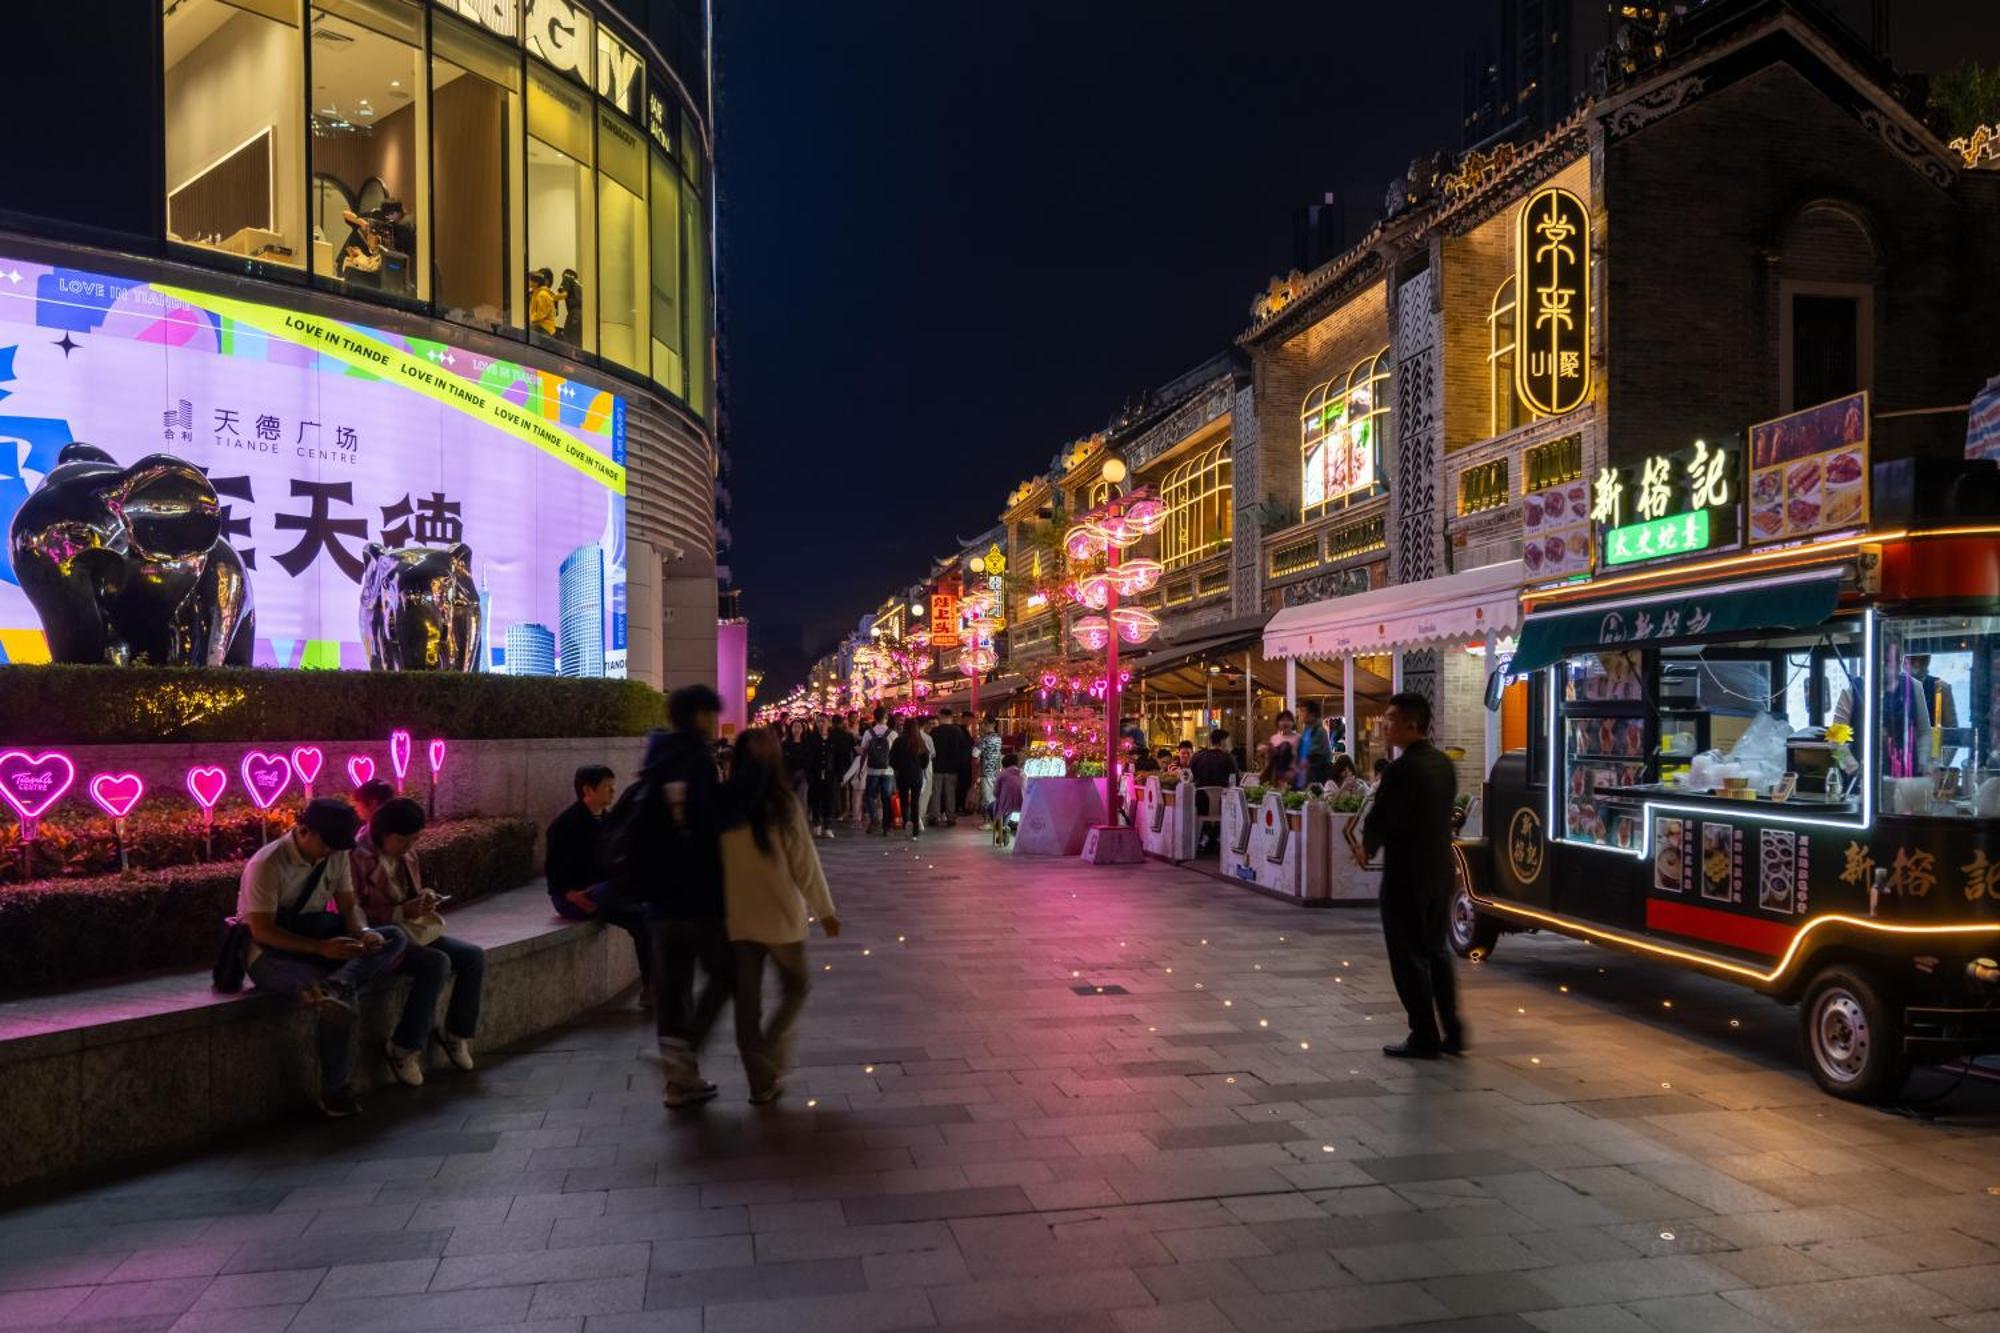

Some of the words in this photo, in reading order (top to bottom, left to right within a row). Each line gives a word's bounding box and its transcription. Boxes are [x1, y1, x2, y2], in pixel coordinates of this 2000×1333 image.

[59, 278, 105, 297] LOVE
[285, 316, 323, 338] LOVE
[325, 330, 341, 344] IN
[342, 337, 390, 366] TIANDE
[401, 363, 432, 386] LOVE
[434, 377, 447, 390] IN
[448, 380, 487, 409] TIANDE
[164, 428, 193, 442] 合利
[213, 408, 358, 453] 天德广场
[494, 405, 519, 425] LOVE
[520, 417, 531, 430] IN
[532, 421, 561, 448] TIANDE
[216, 435, 279, 455] TIANDE
[296, 446, 357, 465] CENTRE
[565, 443, 584, 462] LOVE
[585, 454, 595, 467] IN
[594, 458, 619, 481] TIANDE
[18, 783, 47, 791] CENTRE
